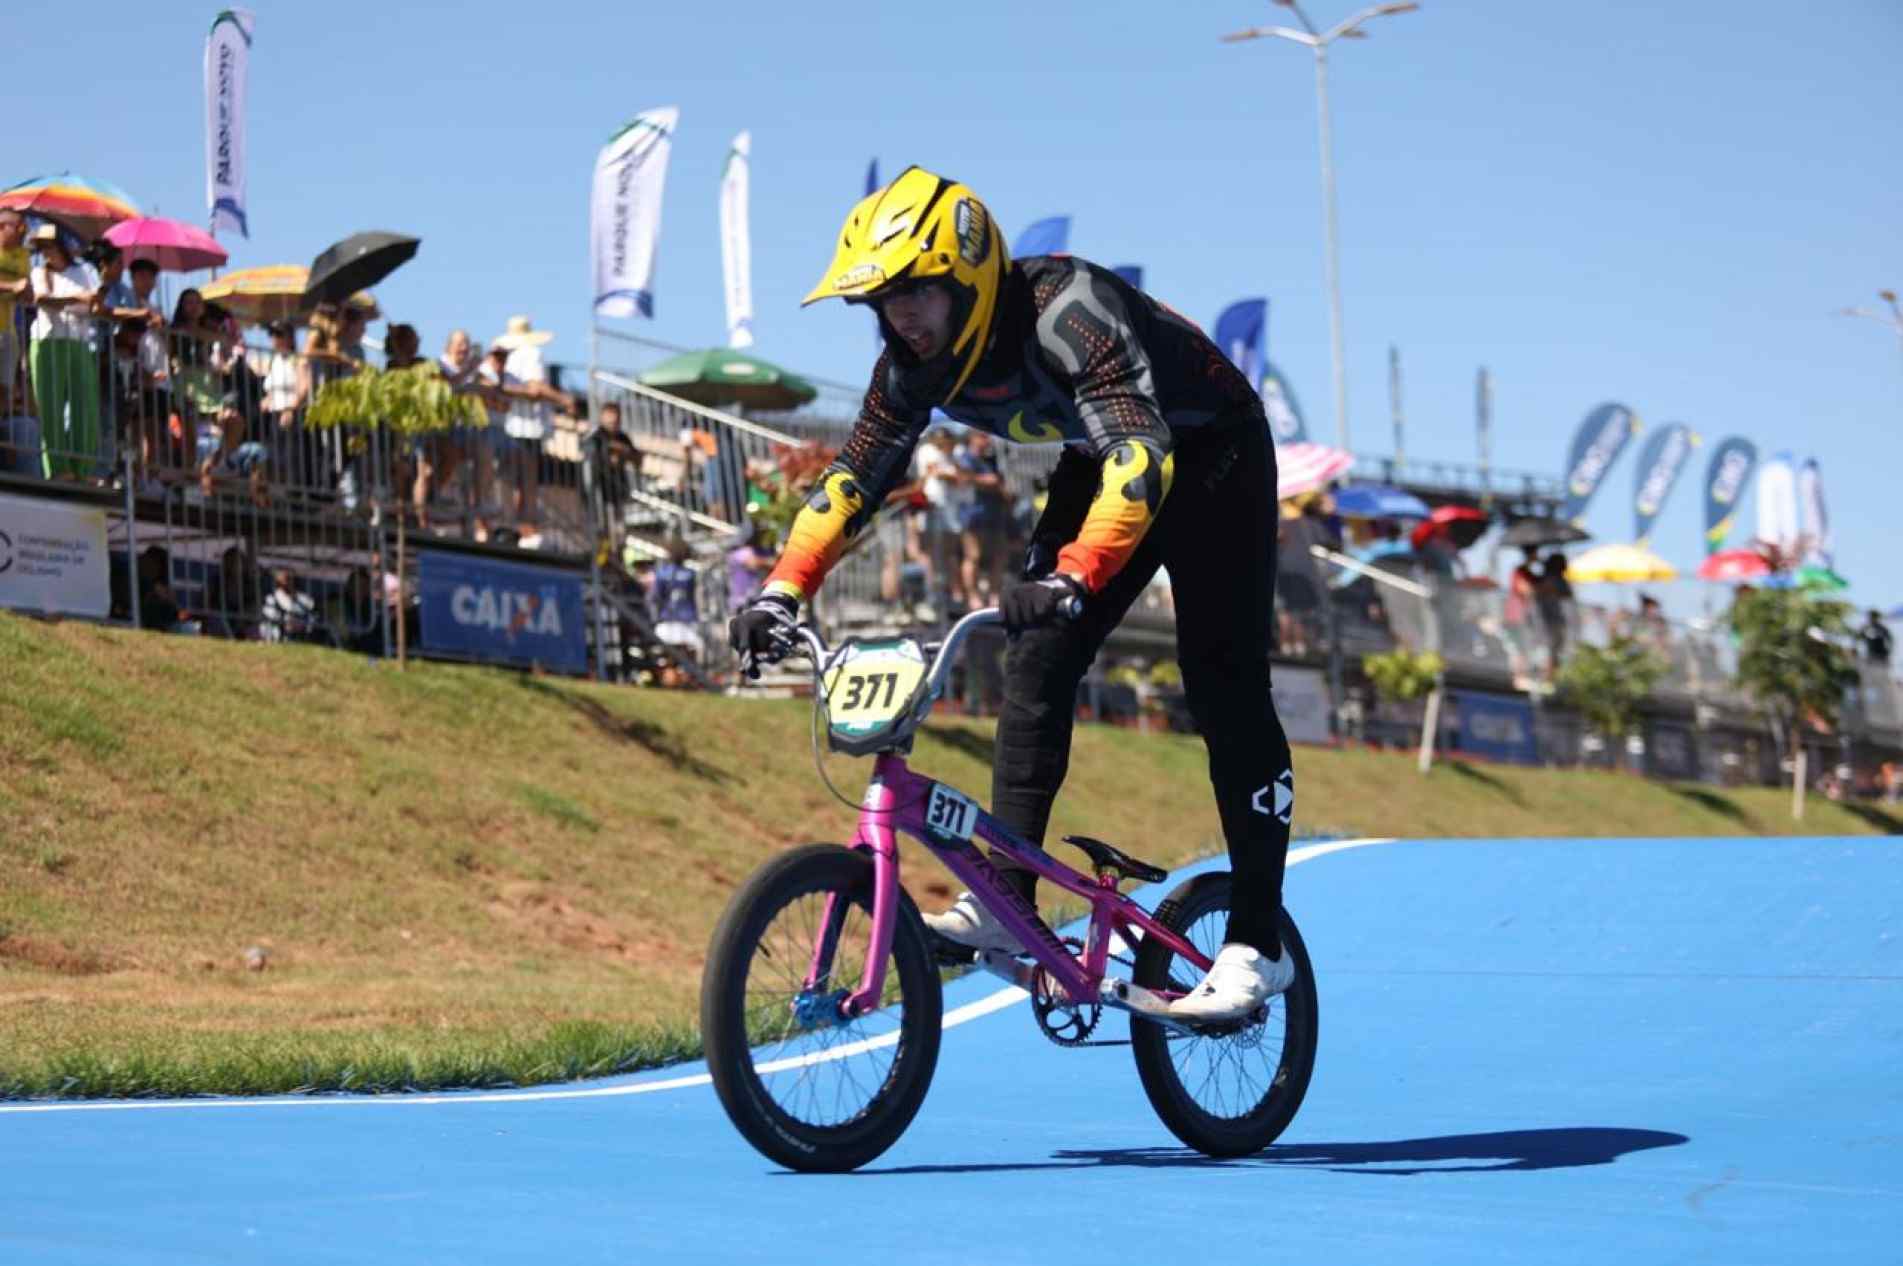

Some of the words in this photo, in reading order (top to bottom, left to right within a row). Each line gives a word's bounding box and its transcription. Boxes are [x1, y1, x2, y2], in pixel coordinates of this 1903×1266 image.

[613, 202, 629, 278] PARQUE
[450, 584, 563, 643] CAIXA
[840, 671, 899, 711] 371
[931, 791, 967, 834] 371
